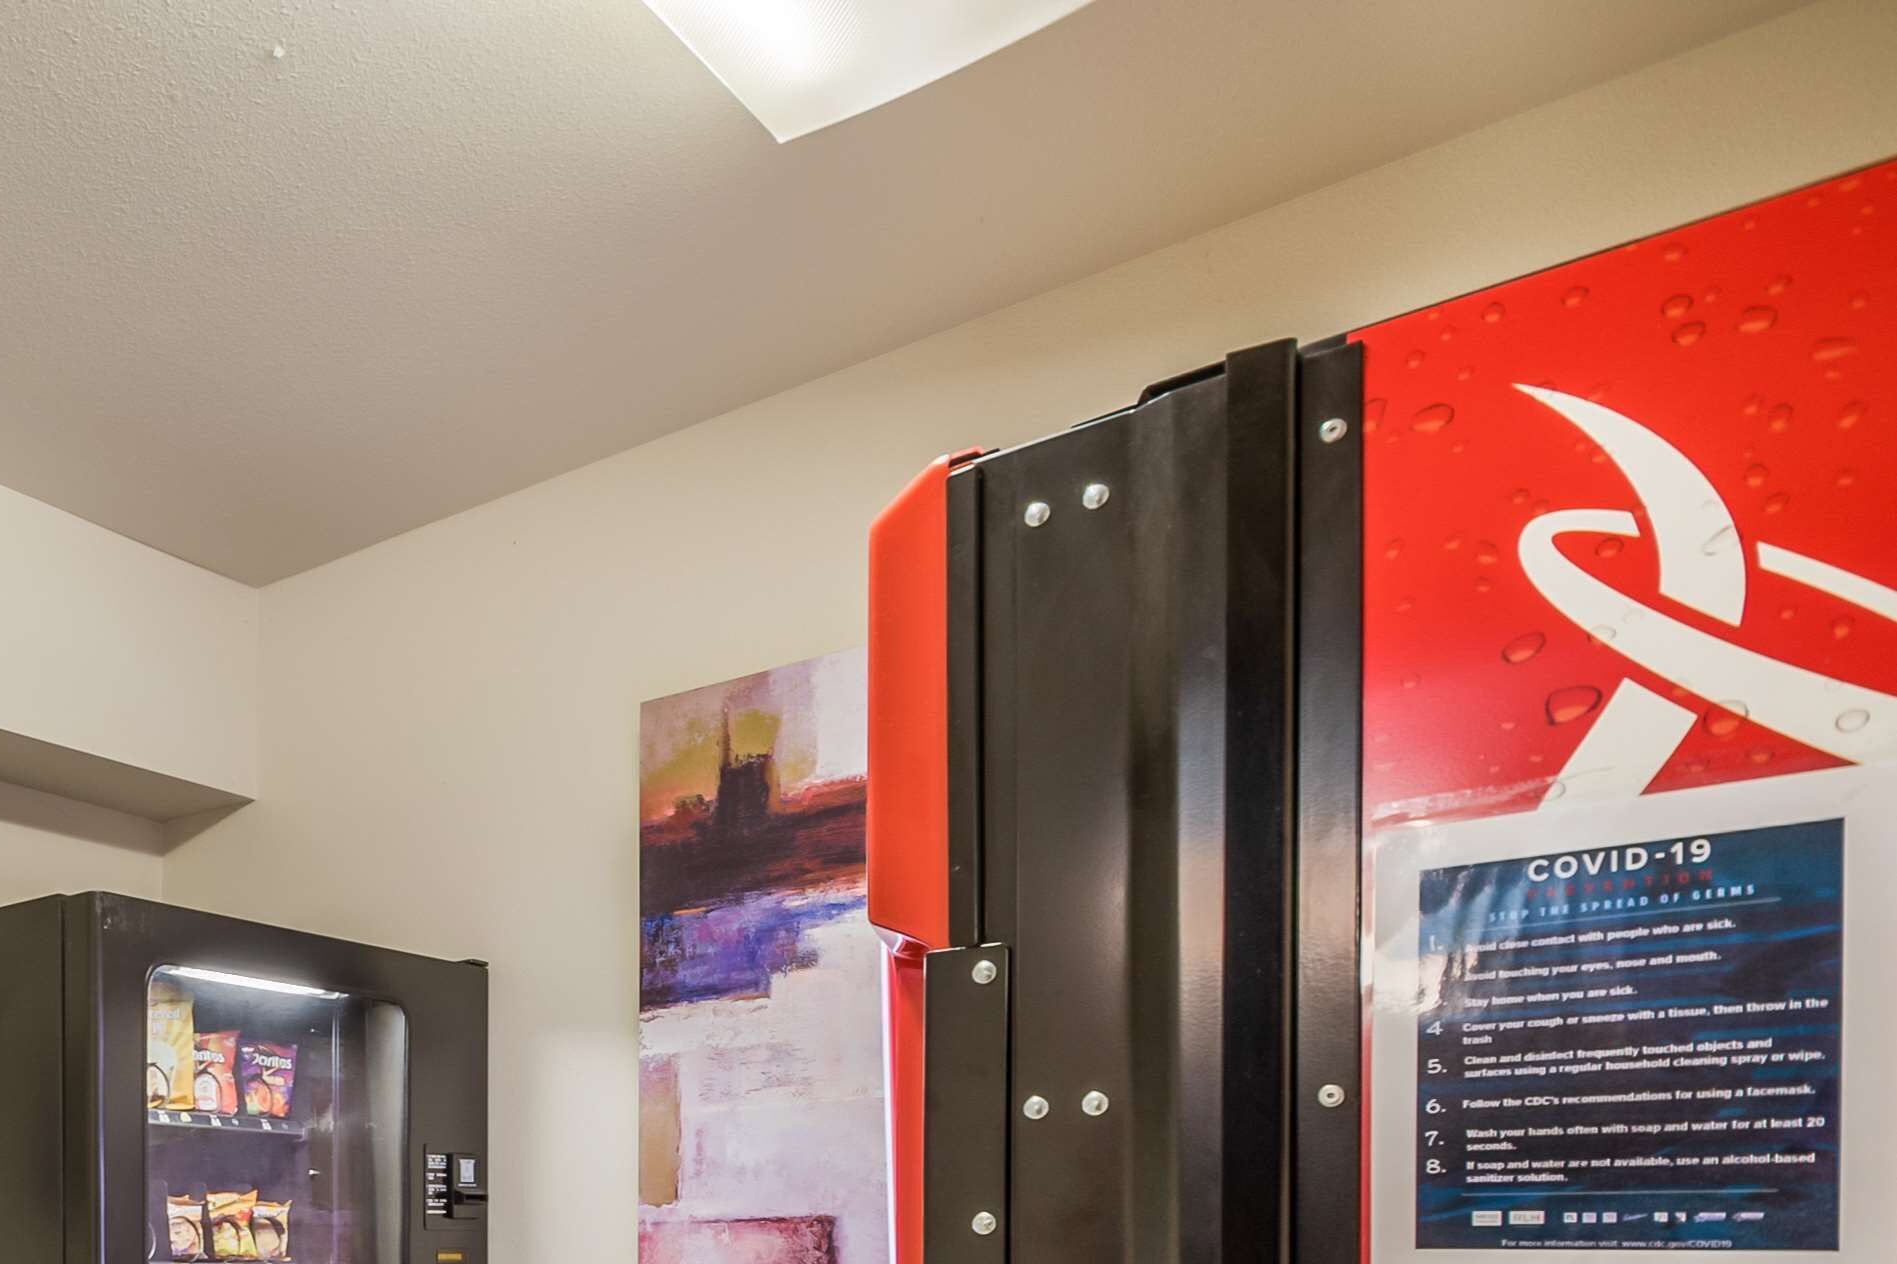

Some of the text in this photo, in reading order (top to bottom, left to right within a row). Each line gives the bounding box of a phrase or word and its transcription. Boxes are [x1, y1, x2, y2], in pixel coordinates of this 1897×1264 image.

[1527, 838, 1712, 882] COVID-19
[1489, 884, 1755, 922] STOP THE SPREAD OF GERMS
[1462, 1022, 1496, 1032] Cover
[1499, 1021, 1524, 1031] your
[1527, 1017, 1563, 1029] cough
[1566, 1016, 1579, 1024] or
[1582, 1013, 1625, 1024] sneeze
[1628, 1010, 1655, 1021] with
[1658, 1010, 1666, 1019] a
[1668, 1006, 1710, 1018] tissue,
[1713, 1004, 1743, 1015] then
[1747, 1001, 1786, 1012] throw
[1789, 1000, 1802, 1010] in
[1805, 998, 1828, 1010] the
[1463, 1035, 1493, 1045] trash
[1427, 1037, 1772, 1074] 5. Clean and disinfect frequently touched objects and
[1464, 1049, 1826, 1079] surfaces using a regular household cleaning spray or wipe.
[1425, 1084, 1816, 1114] 6. Follow the CDC's recommendations for using a facemask.
[1425, 1116, 1825, 1147] 7. Wash your hands often with soap and water for at least 20
[1466, 1141, 1517, 1151] seconds.
[1426, 1152, 1816, 1174] 8. If soap and water are not available, use an alcohol-based
[1466, 1172, 1568, 1183] sanitizer solution.
